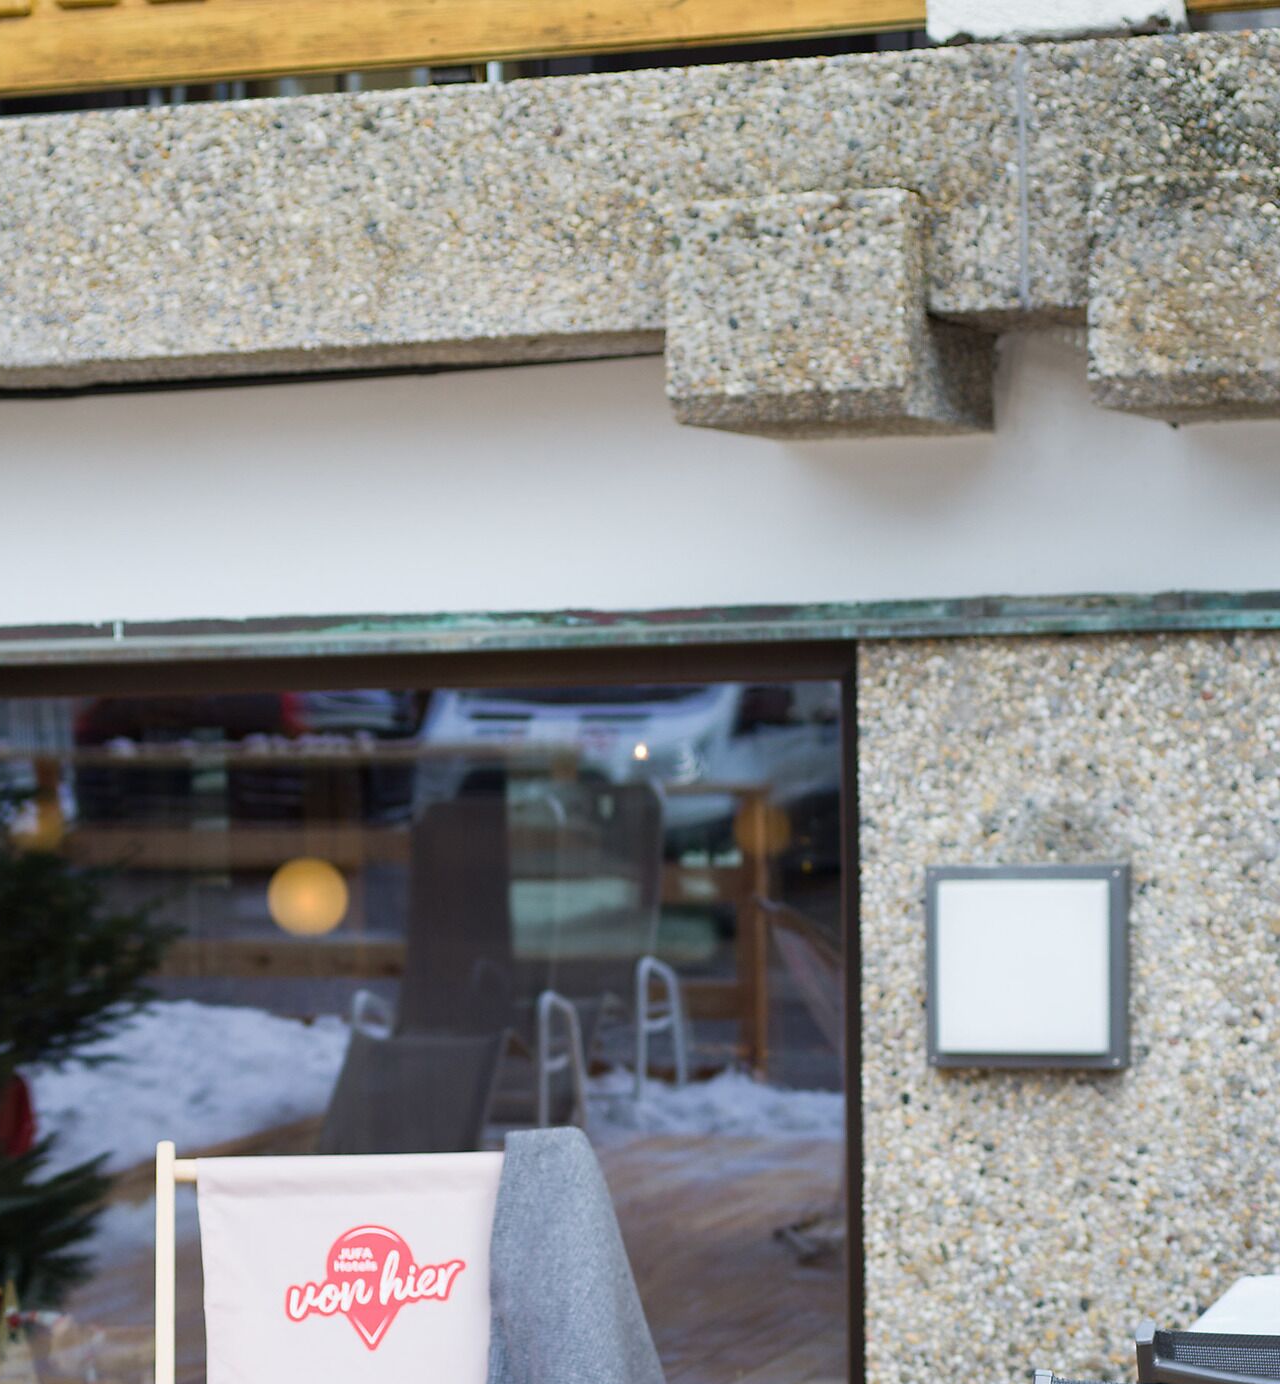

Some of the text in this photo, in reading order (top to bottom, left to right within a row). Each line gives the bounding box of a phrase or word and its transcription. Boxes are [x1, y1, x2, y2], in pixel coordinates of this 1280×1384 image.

[338, 1247, 373, 1260] JUFA
[333, 1260, 378, 1272] Hotels
[289, 1249, 460, 1319] von hier
